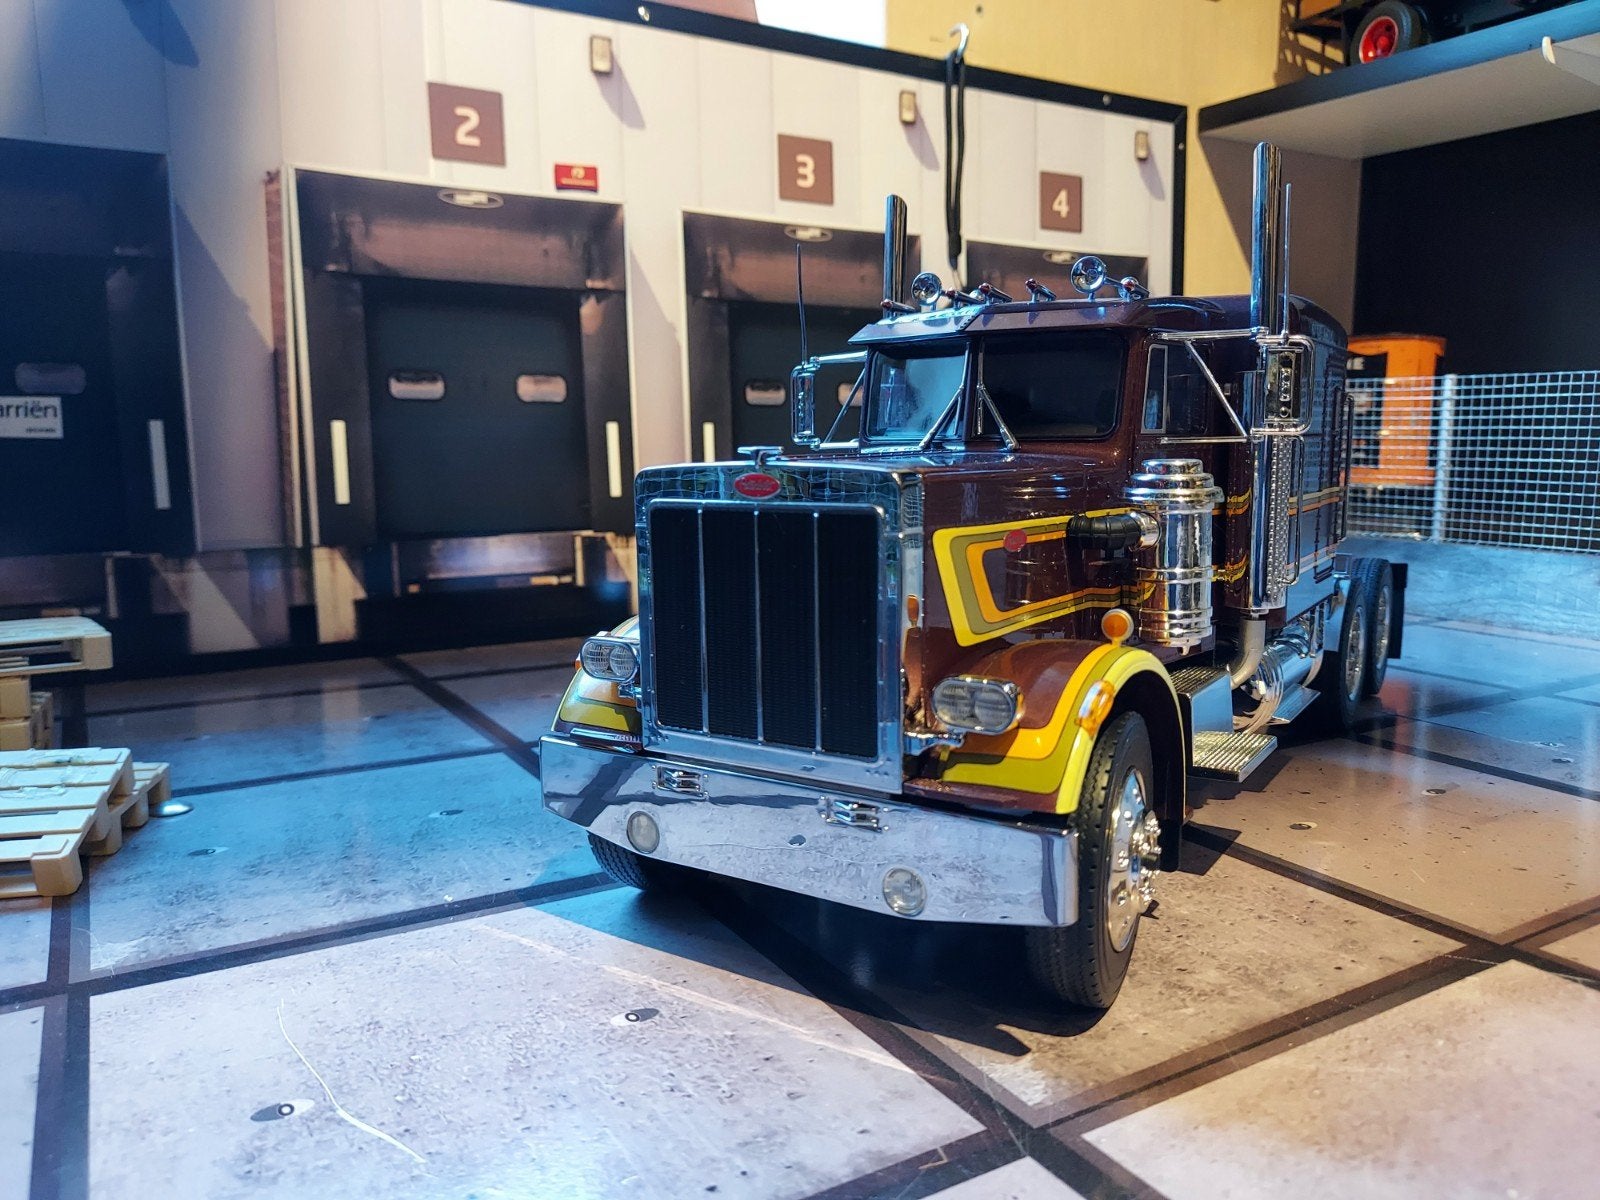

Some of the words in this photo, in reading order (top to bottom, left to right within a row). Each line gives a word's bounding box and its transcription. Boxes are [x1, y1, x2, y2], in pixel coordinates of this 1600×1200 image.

[453, 105, 481, 147] 2
[795, 153, 815, 188] 3
[1051, 188, 1070, 218] 4
